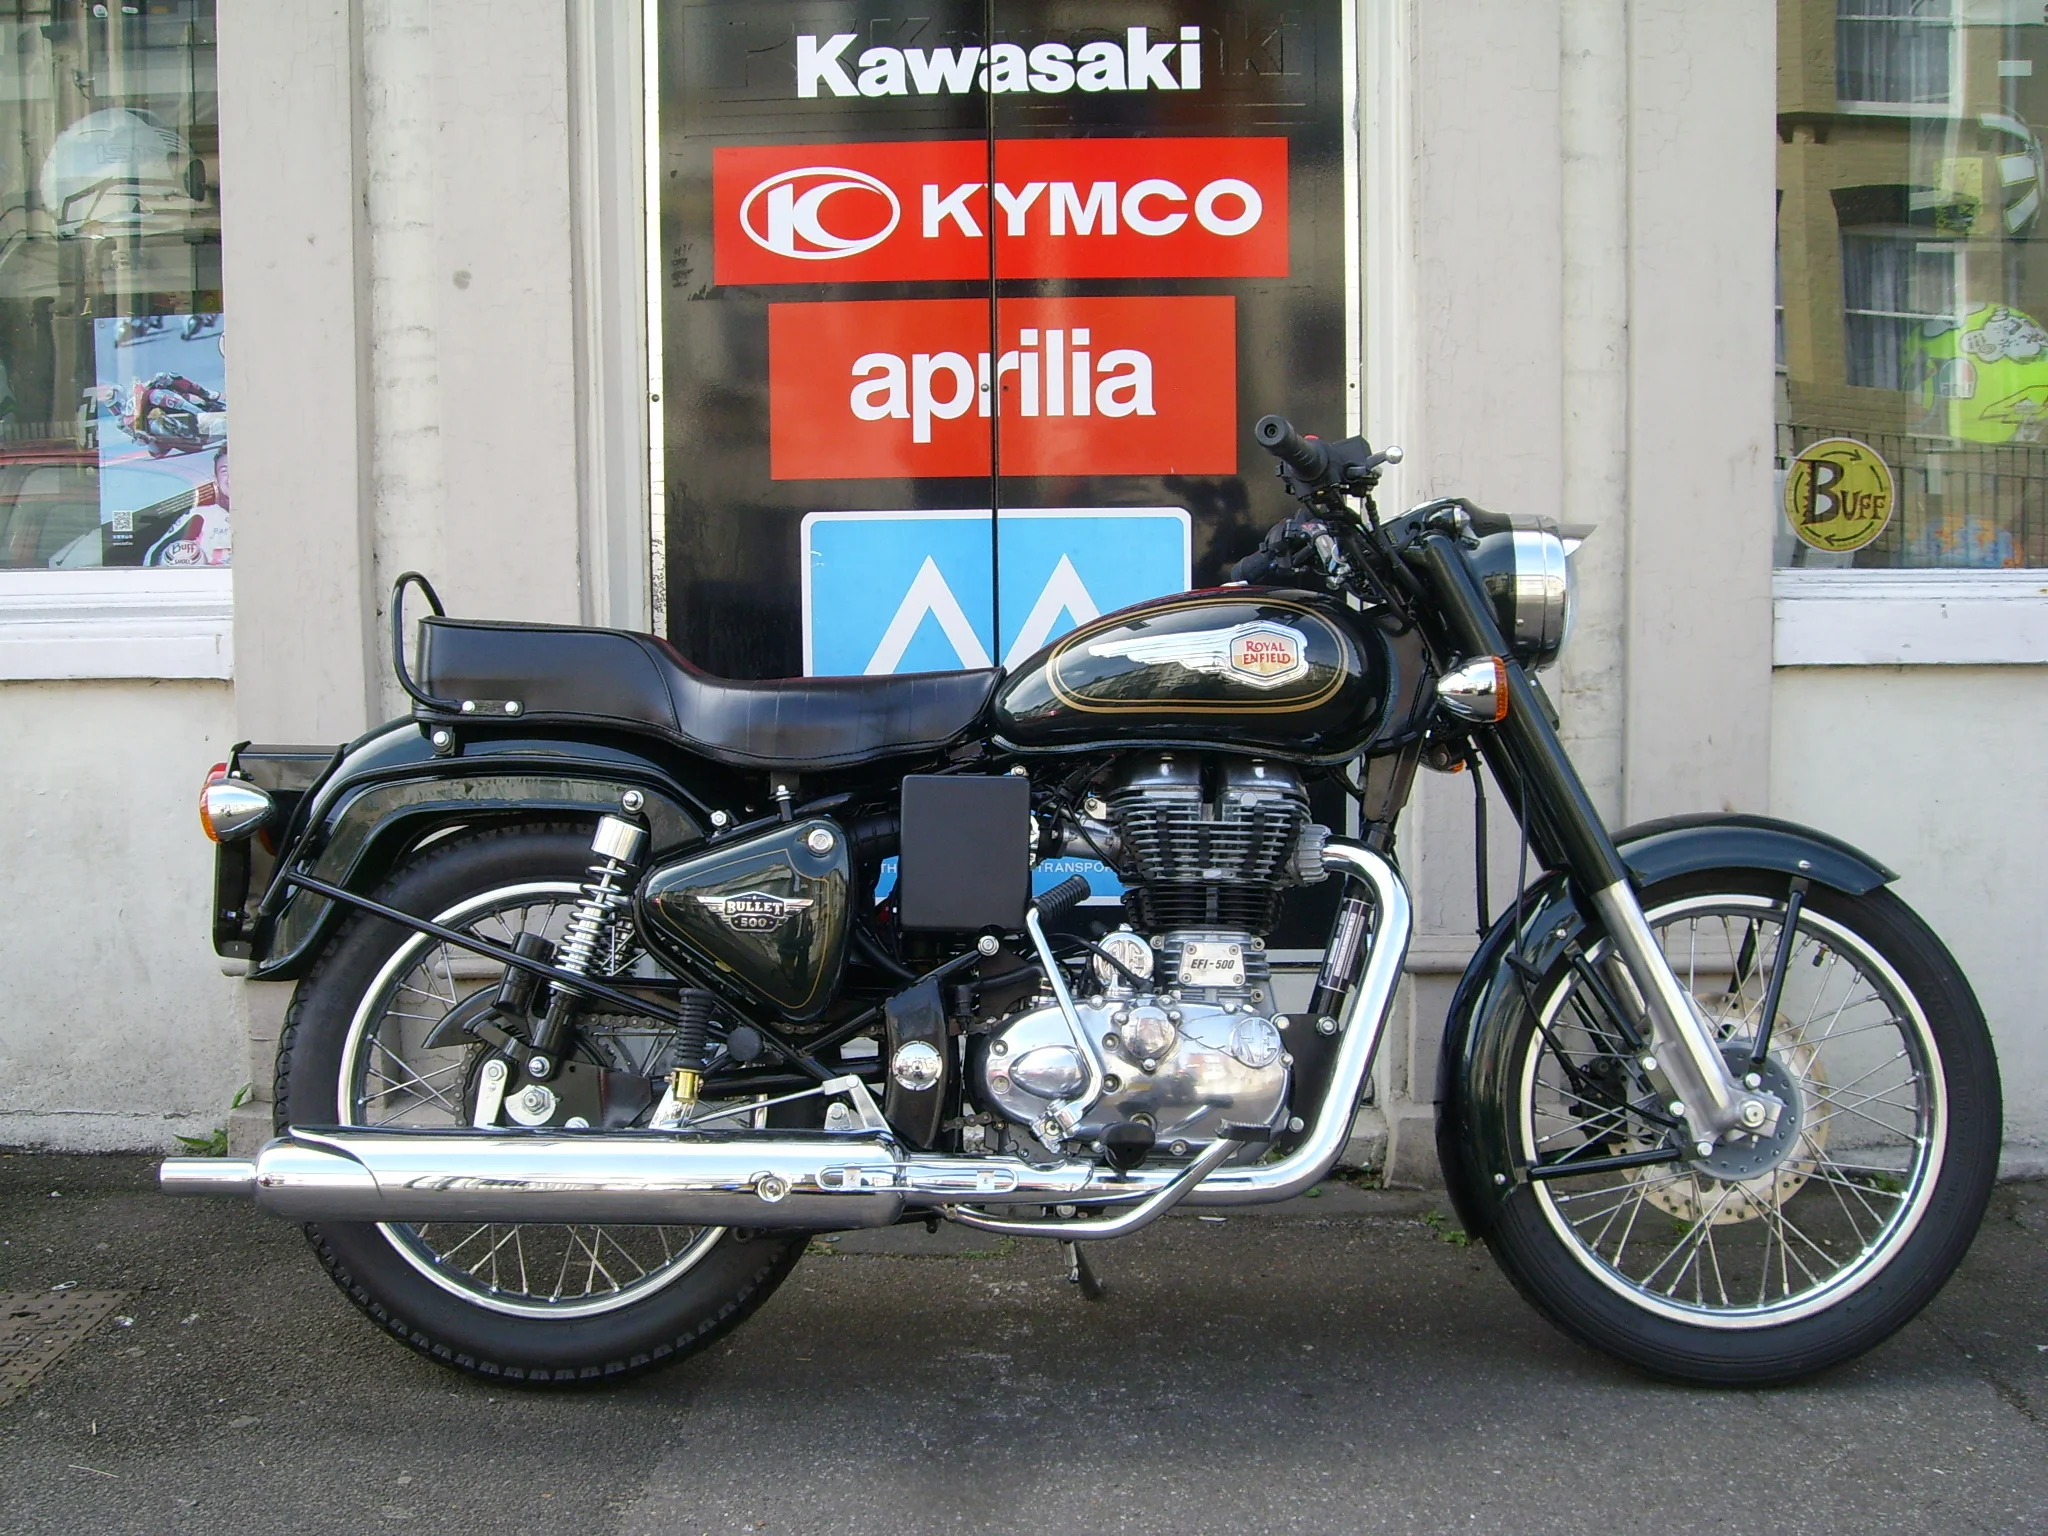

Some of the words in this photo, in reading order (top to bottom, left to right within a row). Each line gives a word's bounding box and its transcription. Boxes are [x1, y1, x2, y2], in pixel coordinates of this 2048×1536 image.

[797, 26, 1201, 98] Kawasaki
[922, 178, 1263, 238] KYMCO
[850, 328, 1156, 443] aprilia
[1245, 640, 1286, 652] ROYAL
[1243, 653, 1291, 665] ENFIELD
[726, 900, 783, 916] BULLET
[740, 917, 767, 927] 500
[1190, 958, 1235, 970] EFI-500
